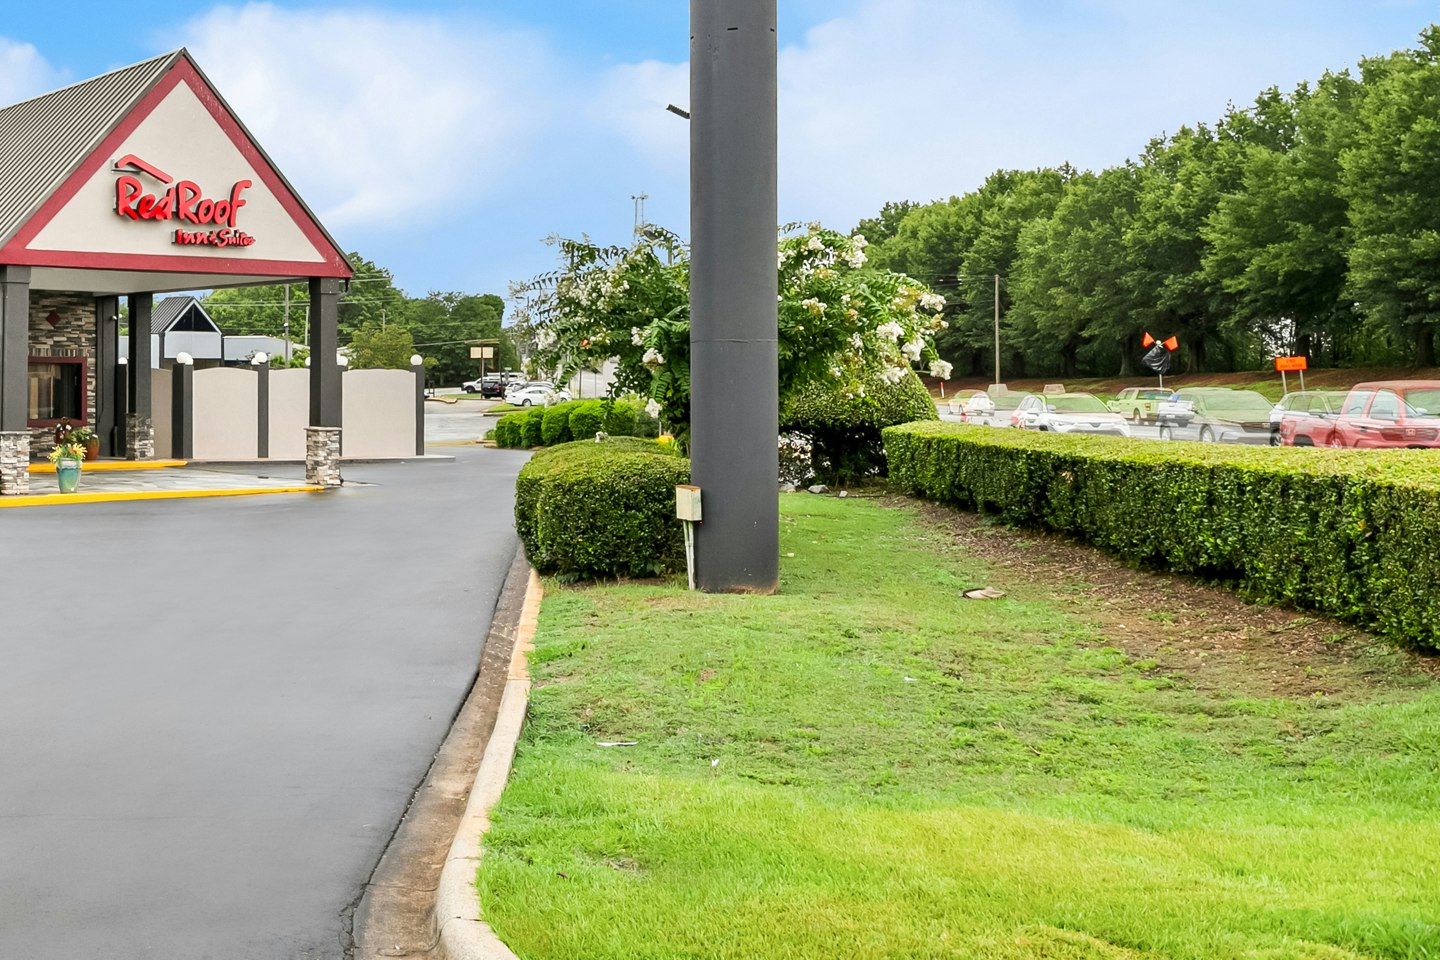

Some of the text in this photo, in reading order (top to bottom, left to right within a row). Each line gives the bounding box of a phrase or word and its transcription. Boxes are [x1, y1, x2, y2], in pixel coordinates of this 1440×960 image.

[116, 176, 252, 227] Red Roof
[175, 229, 208, 246] Inn
[217, 228, 256, 248] Suites
